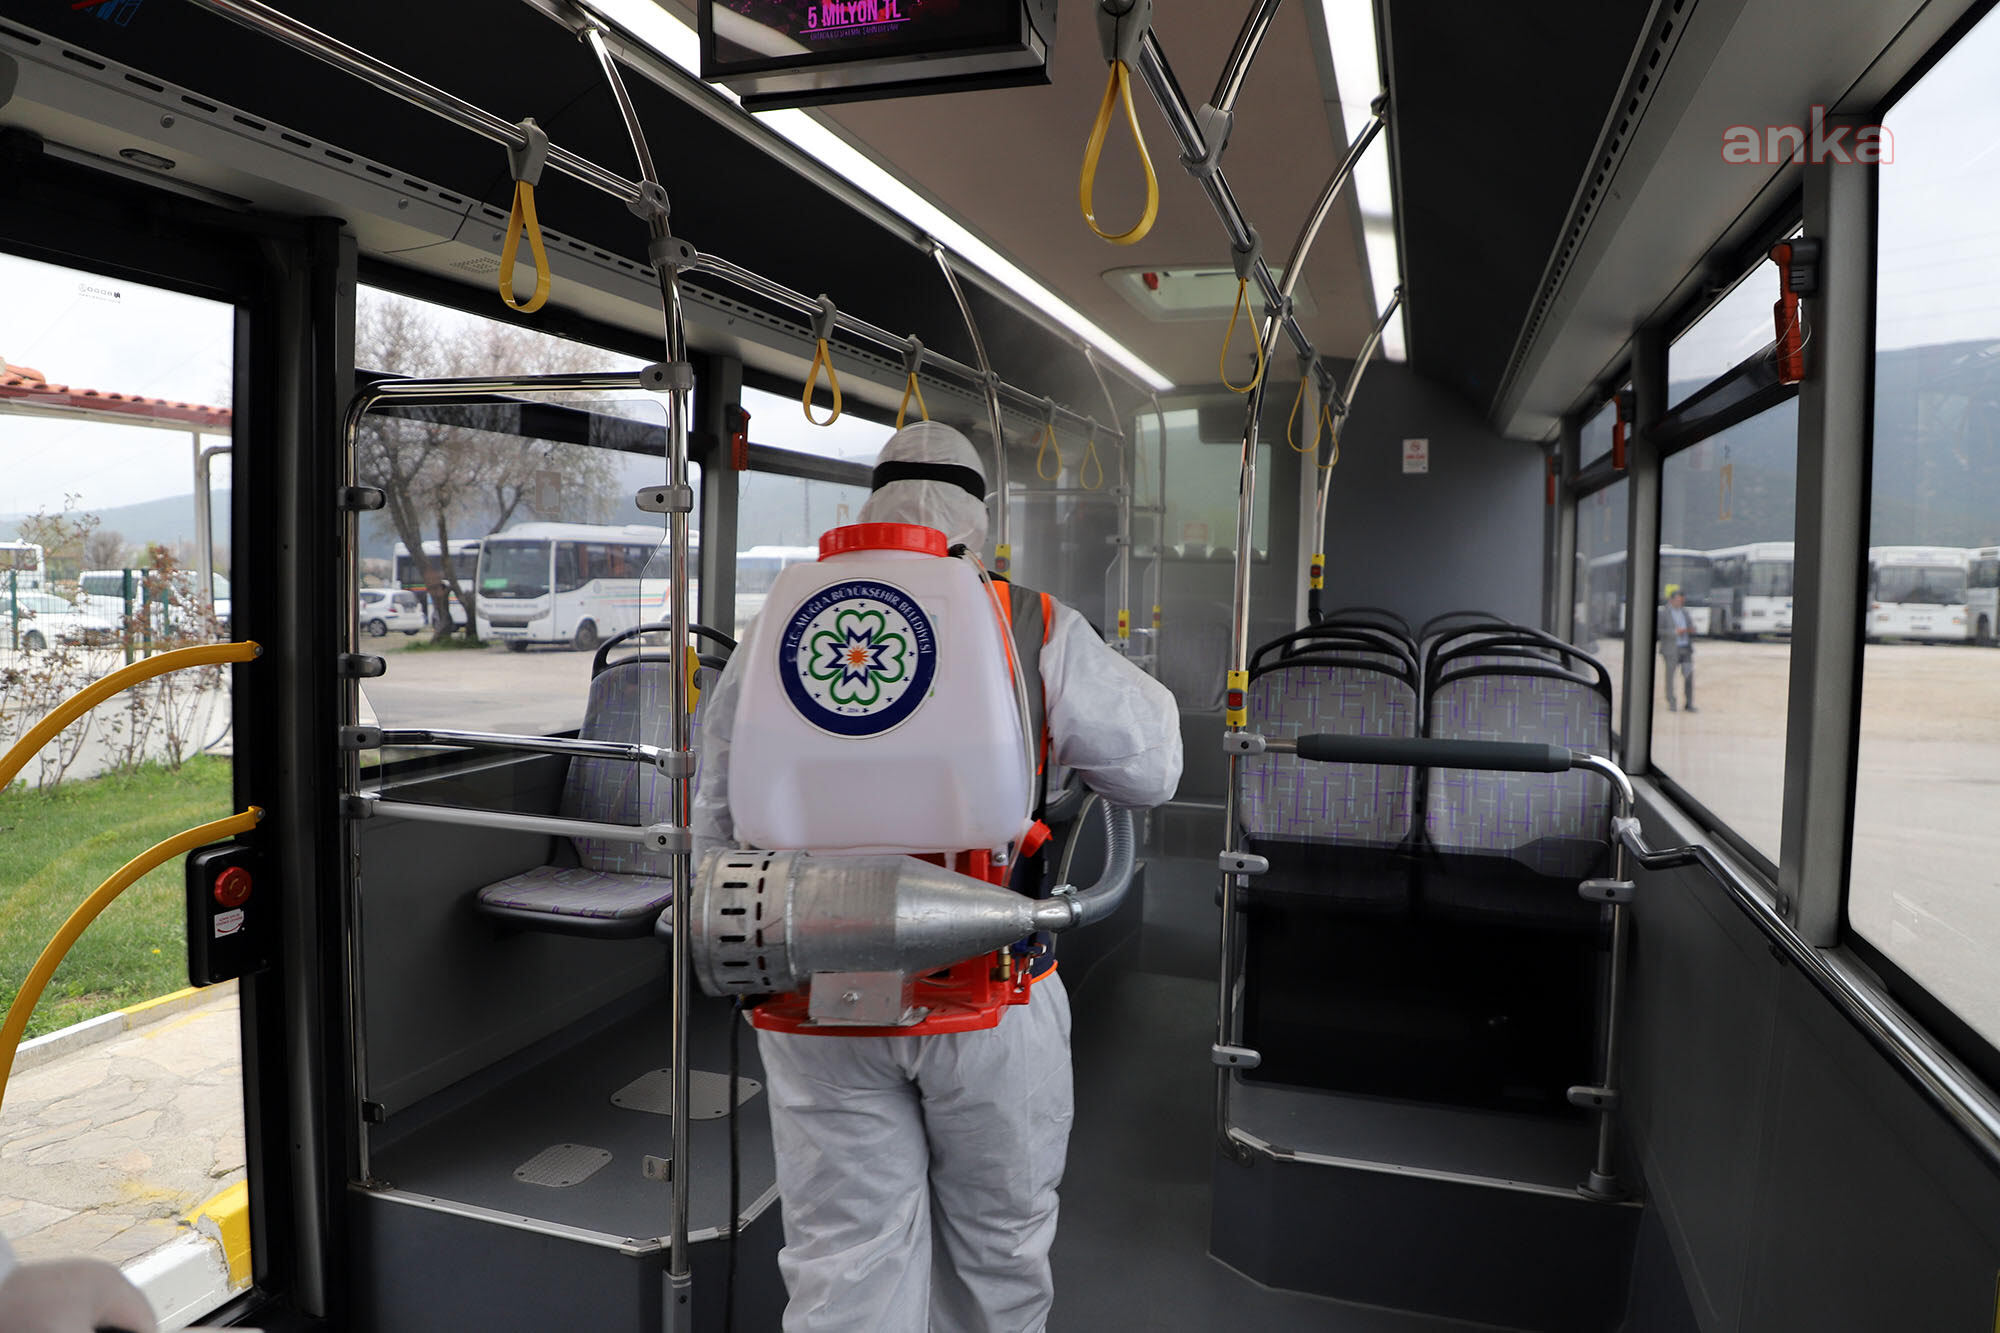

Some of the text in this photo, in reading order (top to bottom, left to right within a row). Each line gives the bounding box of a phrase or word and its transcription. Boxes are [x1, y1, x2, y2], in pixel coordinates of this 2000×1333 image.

[808, 0, 901, 28] 5 MİLYON TL
